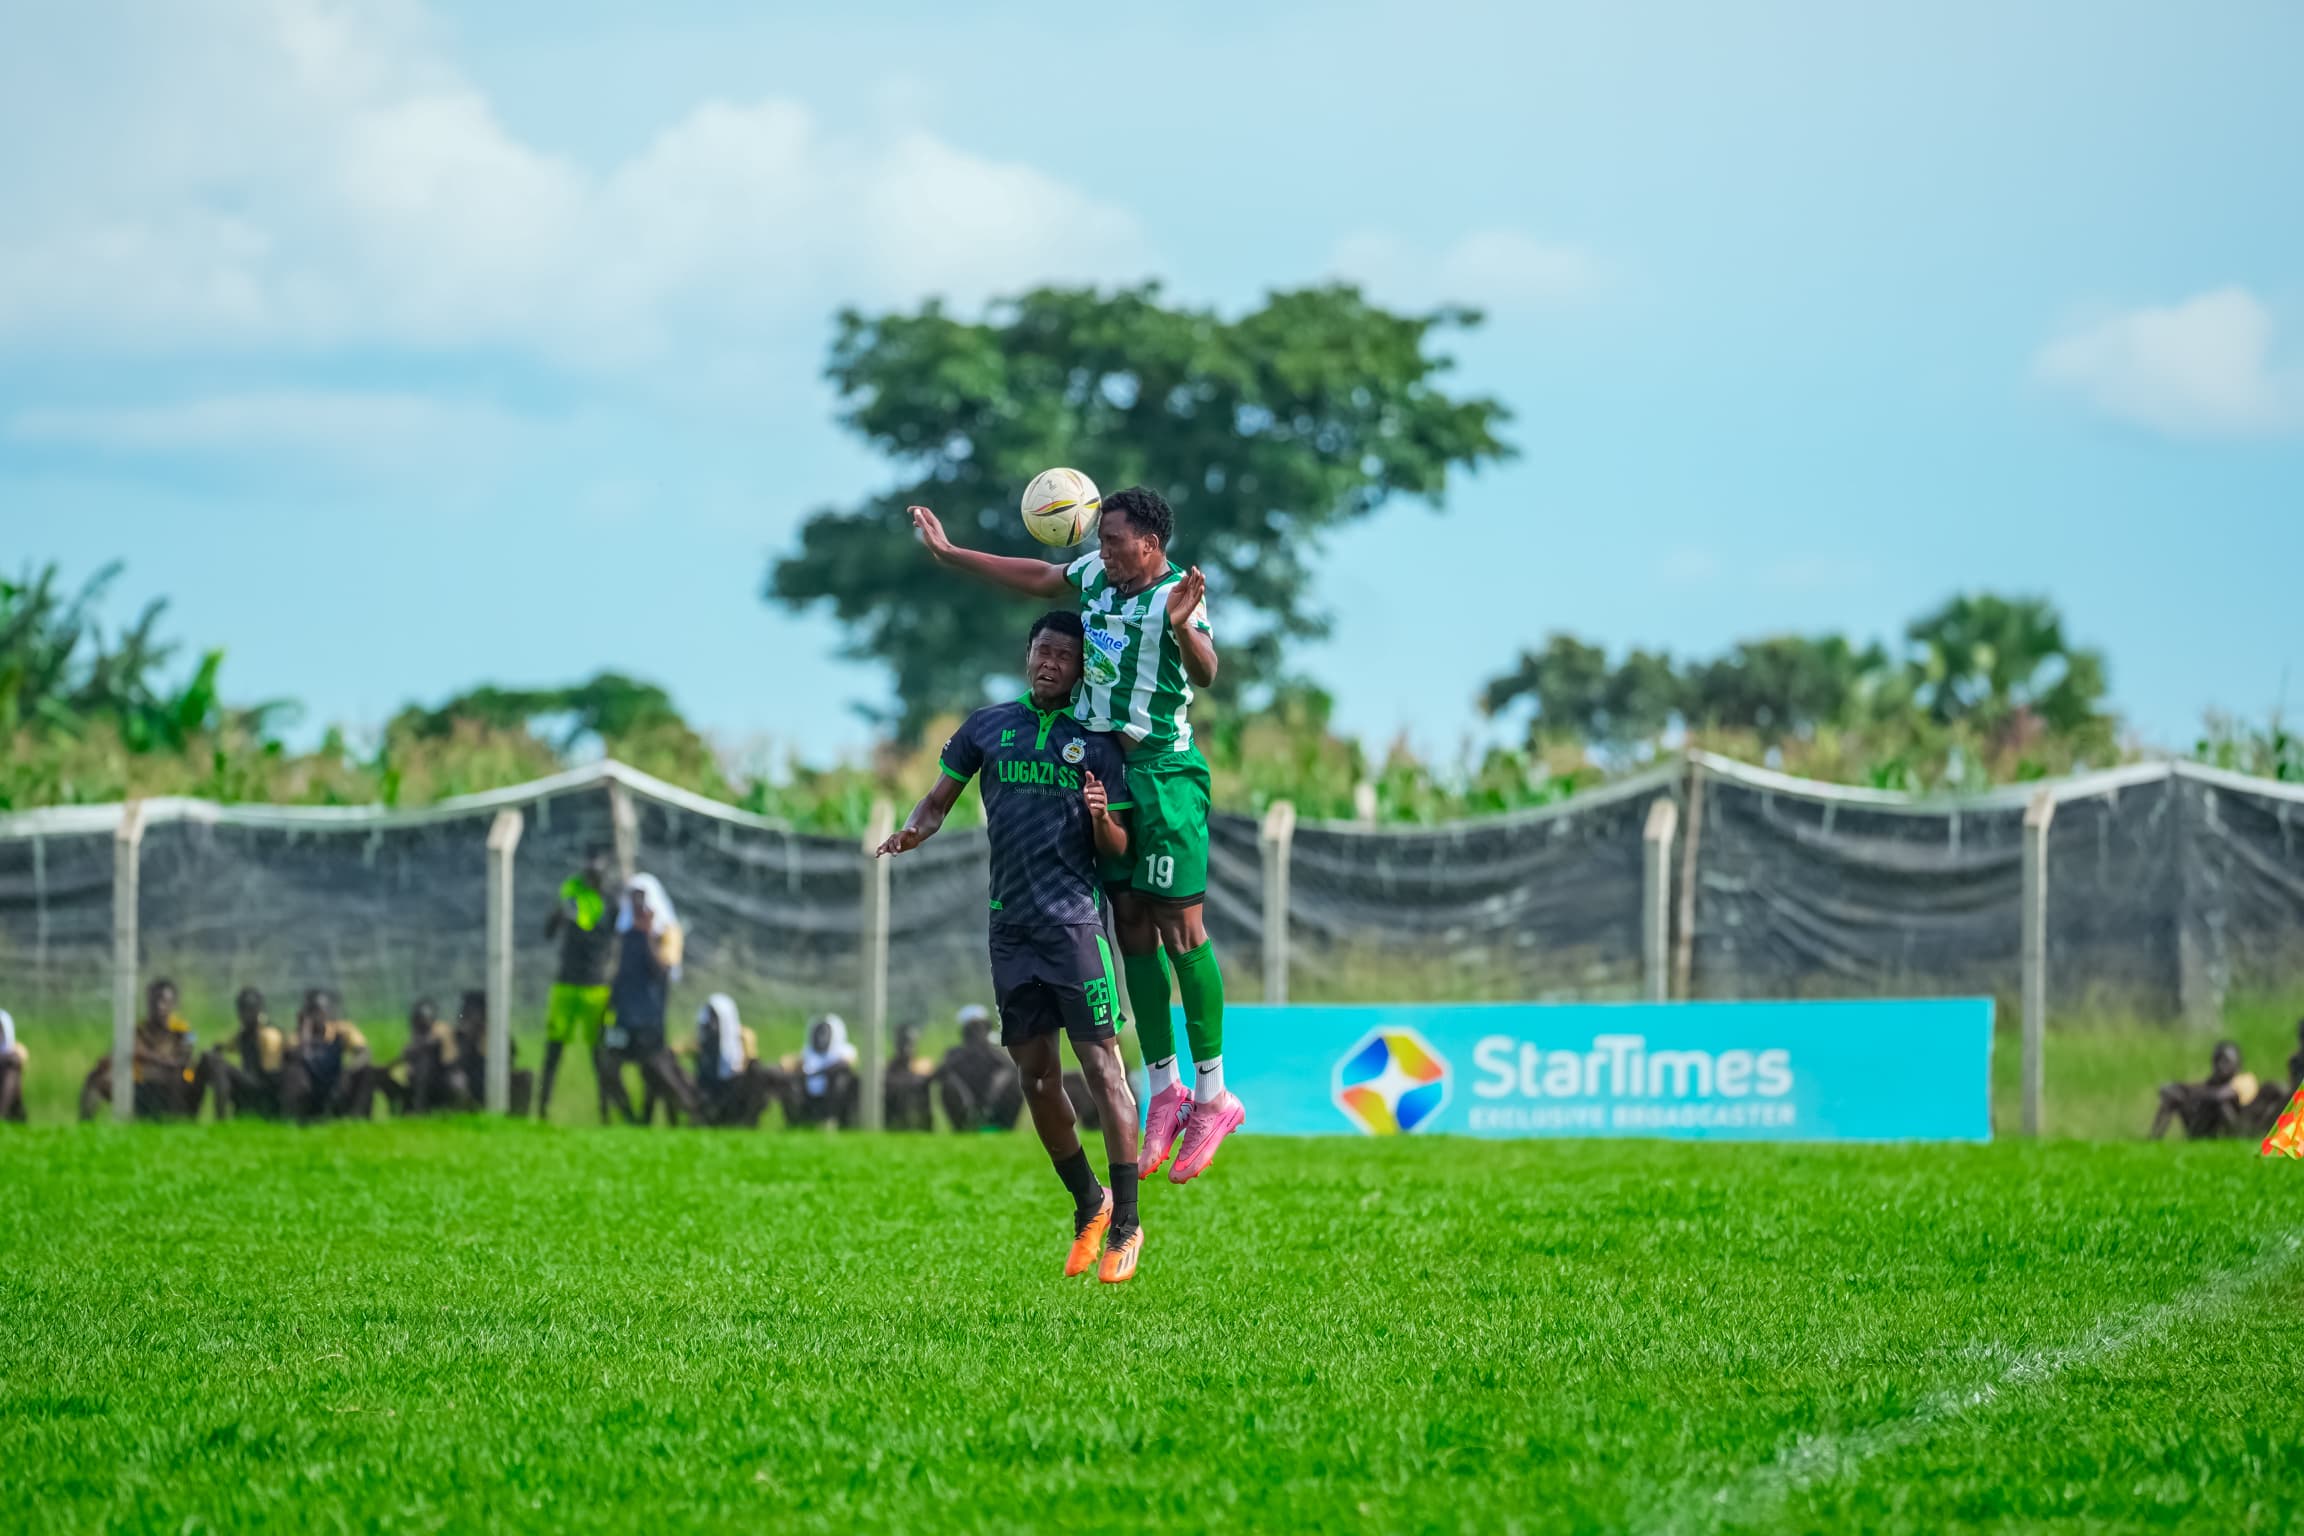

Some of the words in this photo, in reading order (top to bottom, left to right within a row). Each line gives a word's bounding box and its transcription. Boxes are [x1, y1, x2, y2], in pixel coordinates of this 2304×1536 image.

[998, 760, 1055, 785] LUGAZI
[1058, 765, 1080, 791] SS
[1145, 853, 1175, 889] 19
[1083, 977, 1109, 1007] 26
[1472, 1033, 1794, 1099] StarTimes
[1468, 1105, 1605, 1130] EXCLUSIVE
[1612, 1103, 1797, 1128] BROADCASTER
